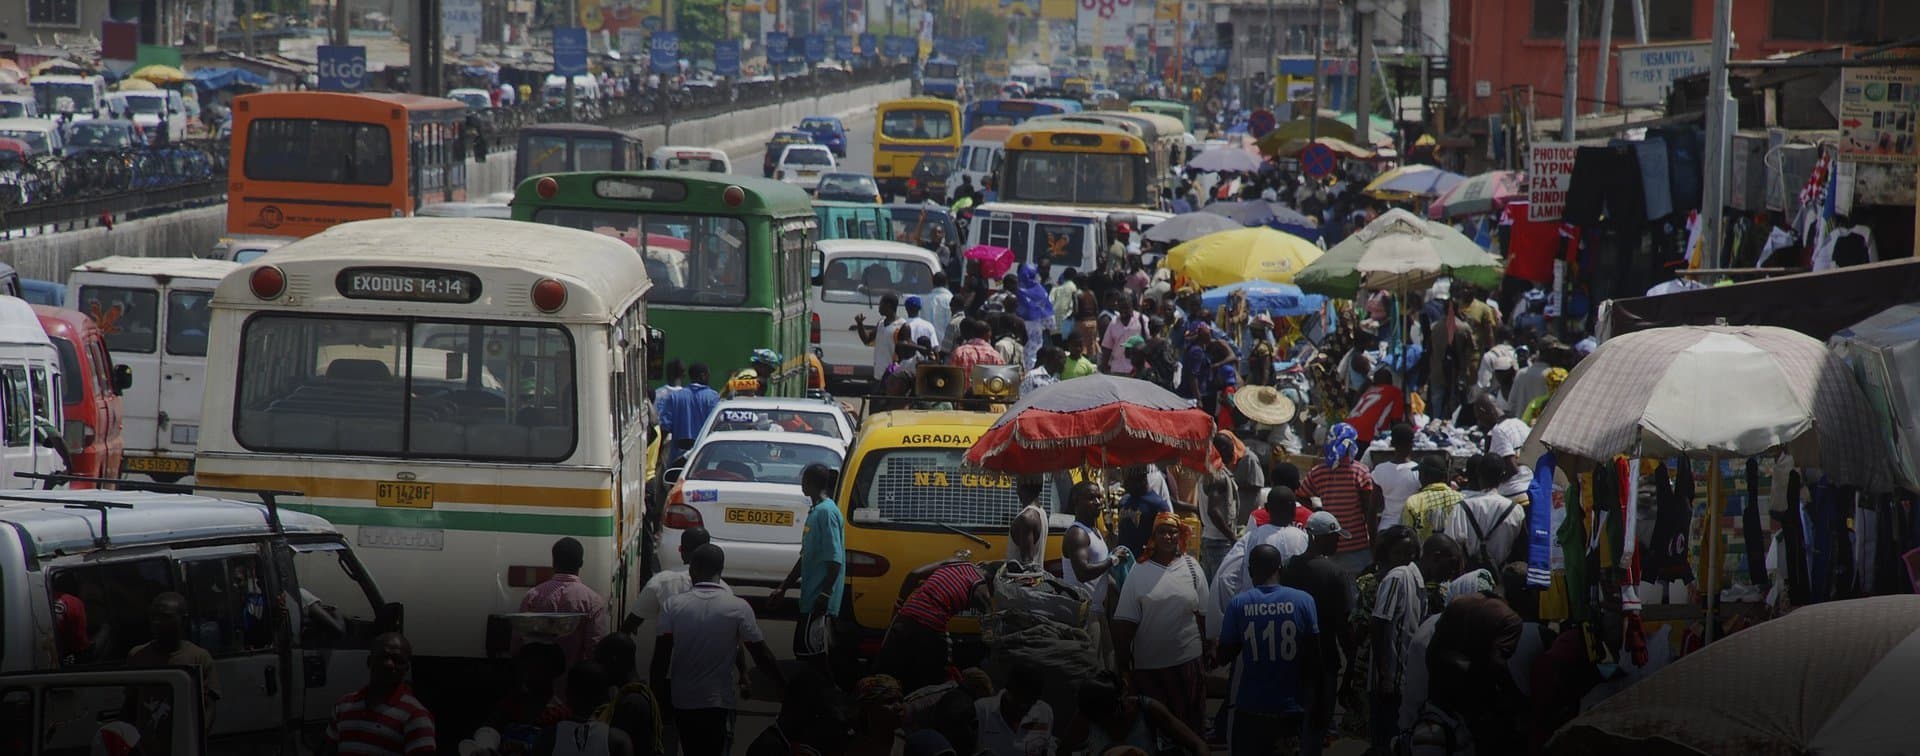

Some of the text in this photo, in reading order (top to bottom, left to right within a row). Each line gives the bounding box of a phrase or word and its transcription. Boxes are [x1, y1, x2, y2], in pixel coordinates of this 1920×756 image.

[1533, 176, 1557, 189] FAX
[353, 276, 462, 294] EXODUS 14:14
[725, 410, 753, 421] TAXI
[902, 434, 972, 445] AGRADAA
[914, 472, 950, 487] NA
[379, 484, 392, 498] GT
[728, 510, 745, 522] GE
[747, 511, 773, 523] 6031
[1243, 601, 1295, 617] MICCRO
[1243, 620, 1297, 662] 118
